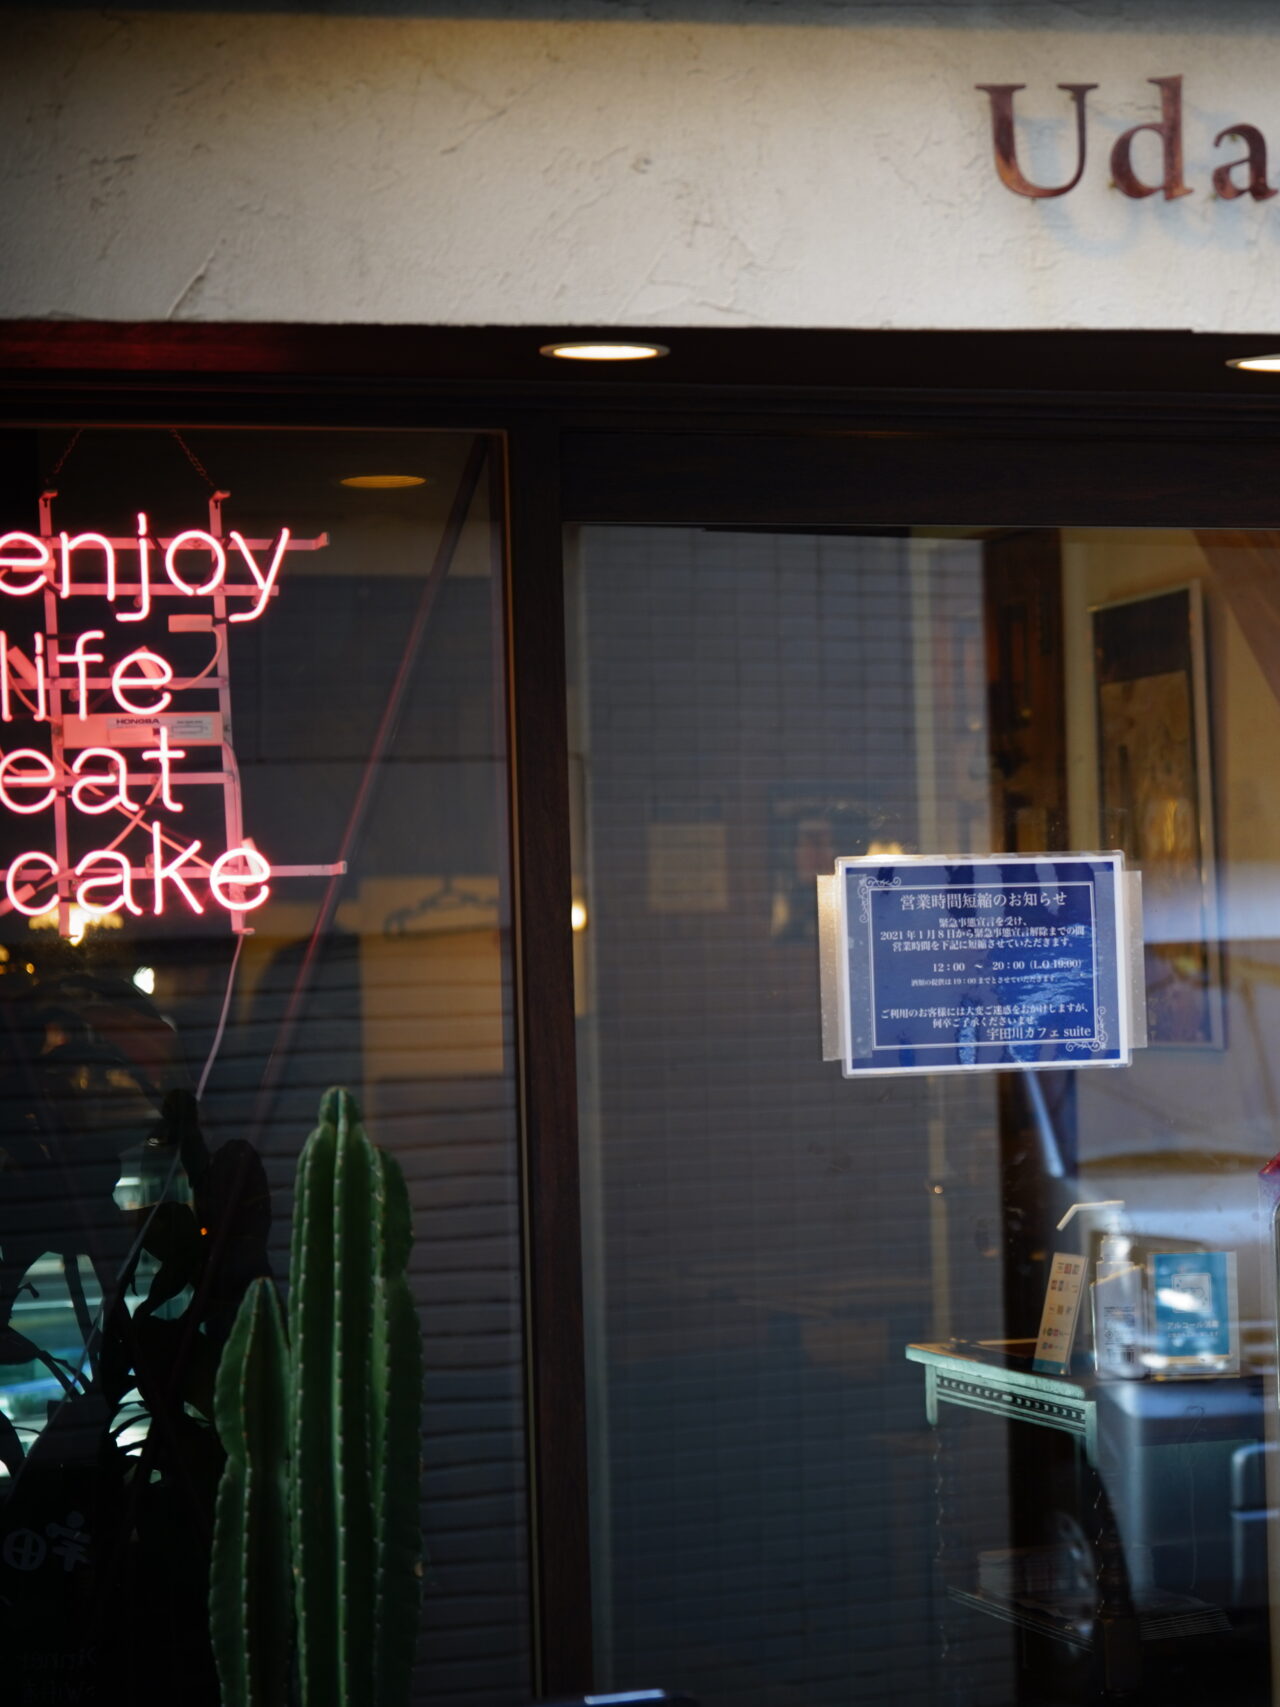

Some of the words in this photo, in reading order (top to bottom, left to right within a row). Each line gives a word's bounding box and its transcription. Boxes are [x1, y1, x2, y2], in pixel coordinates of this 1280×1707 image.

[0, 512, 290, 622] enjoy
[0, 727, 185, 814] eat
[6, 821, 271, 916] cake
[900, 891, 1067, 911] 営業時間短縮のお知らせ
